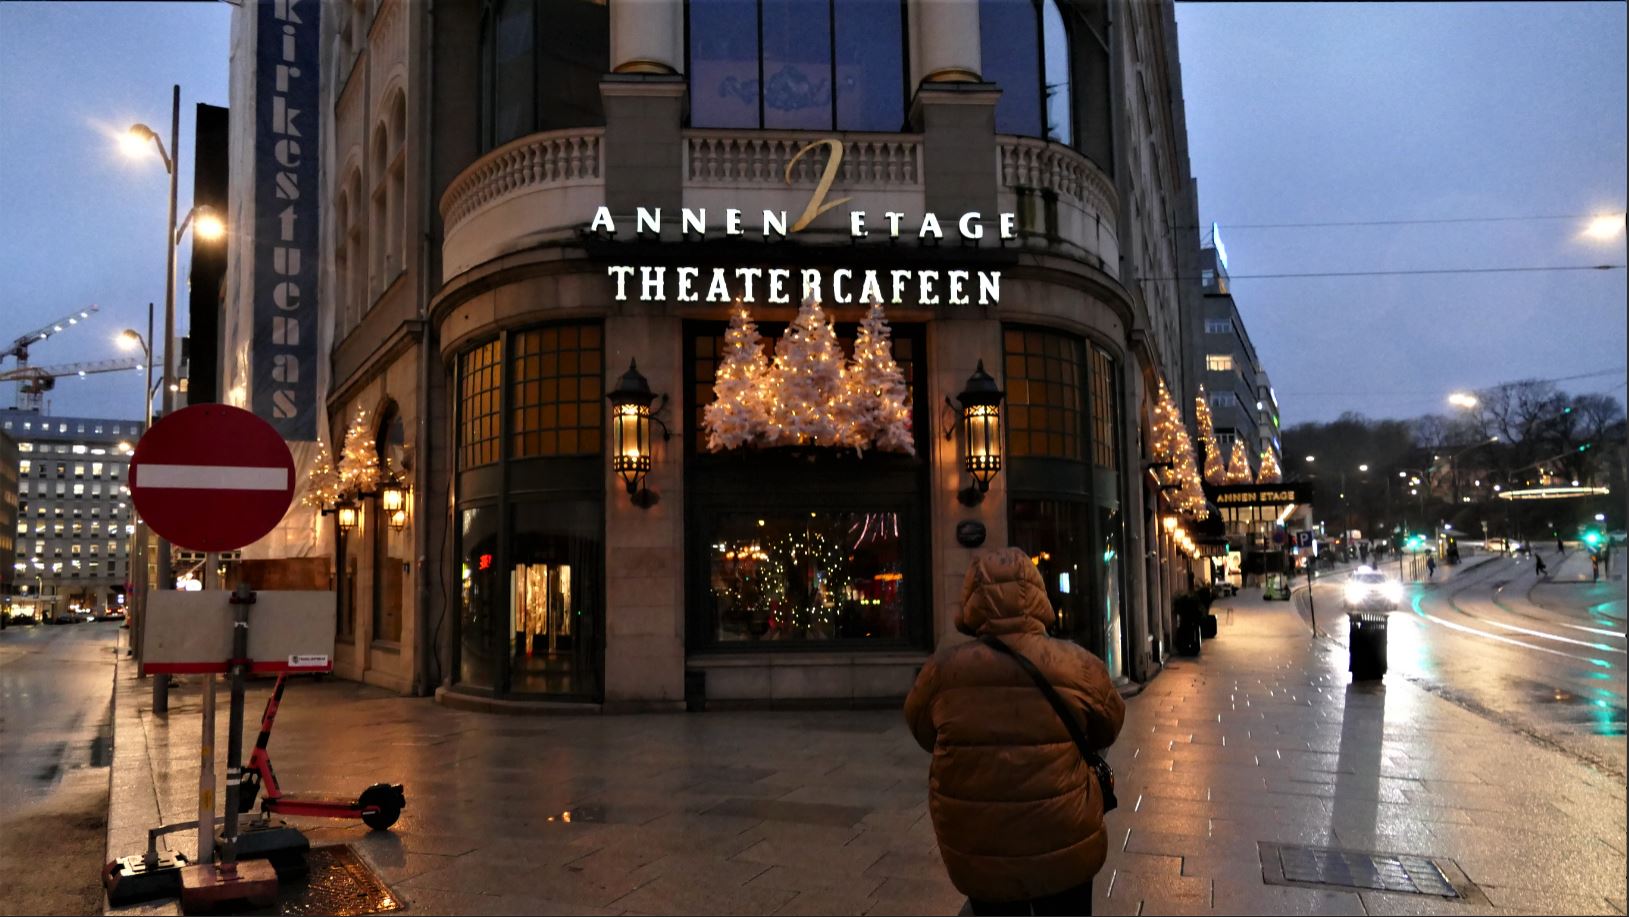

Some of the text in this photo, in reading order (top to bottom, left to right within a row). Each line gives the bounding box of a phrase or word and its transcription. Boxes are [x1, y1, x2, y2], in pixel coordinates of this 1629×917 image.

[591, 139, 1018, 239] ANNEN 2 ETAGE
[608, 265, 1001, 305] THEATERCAFEEN
[1217, 490, 1295, 502] ANNEN ETAGE
